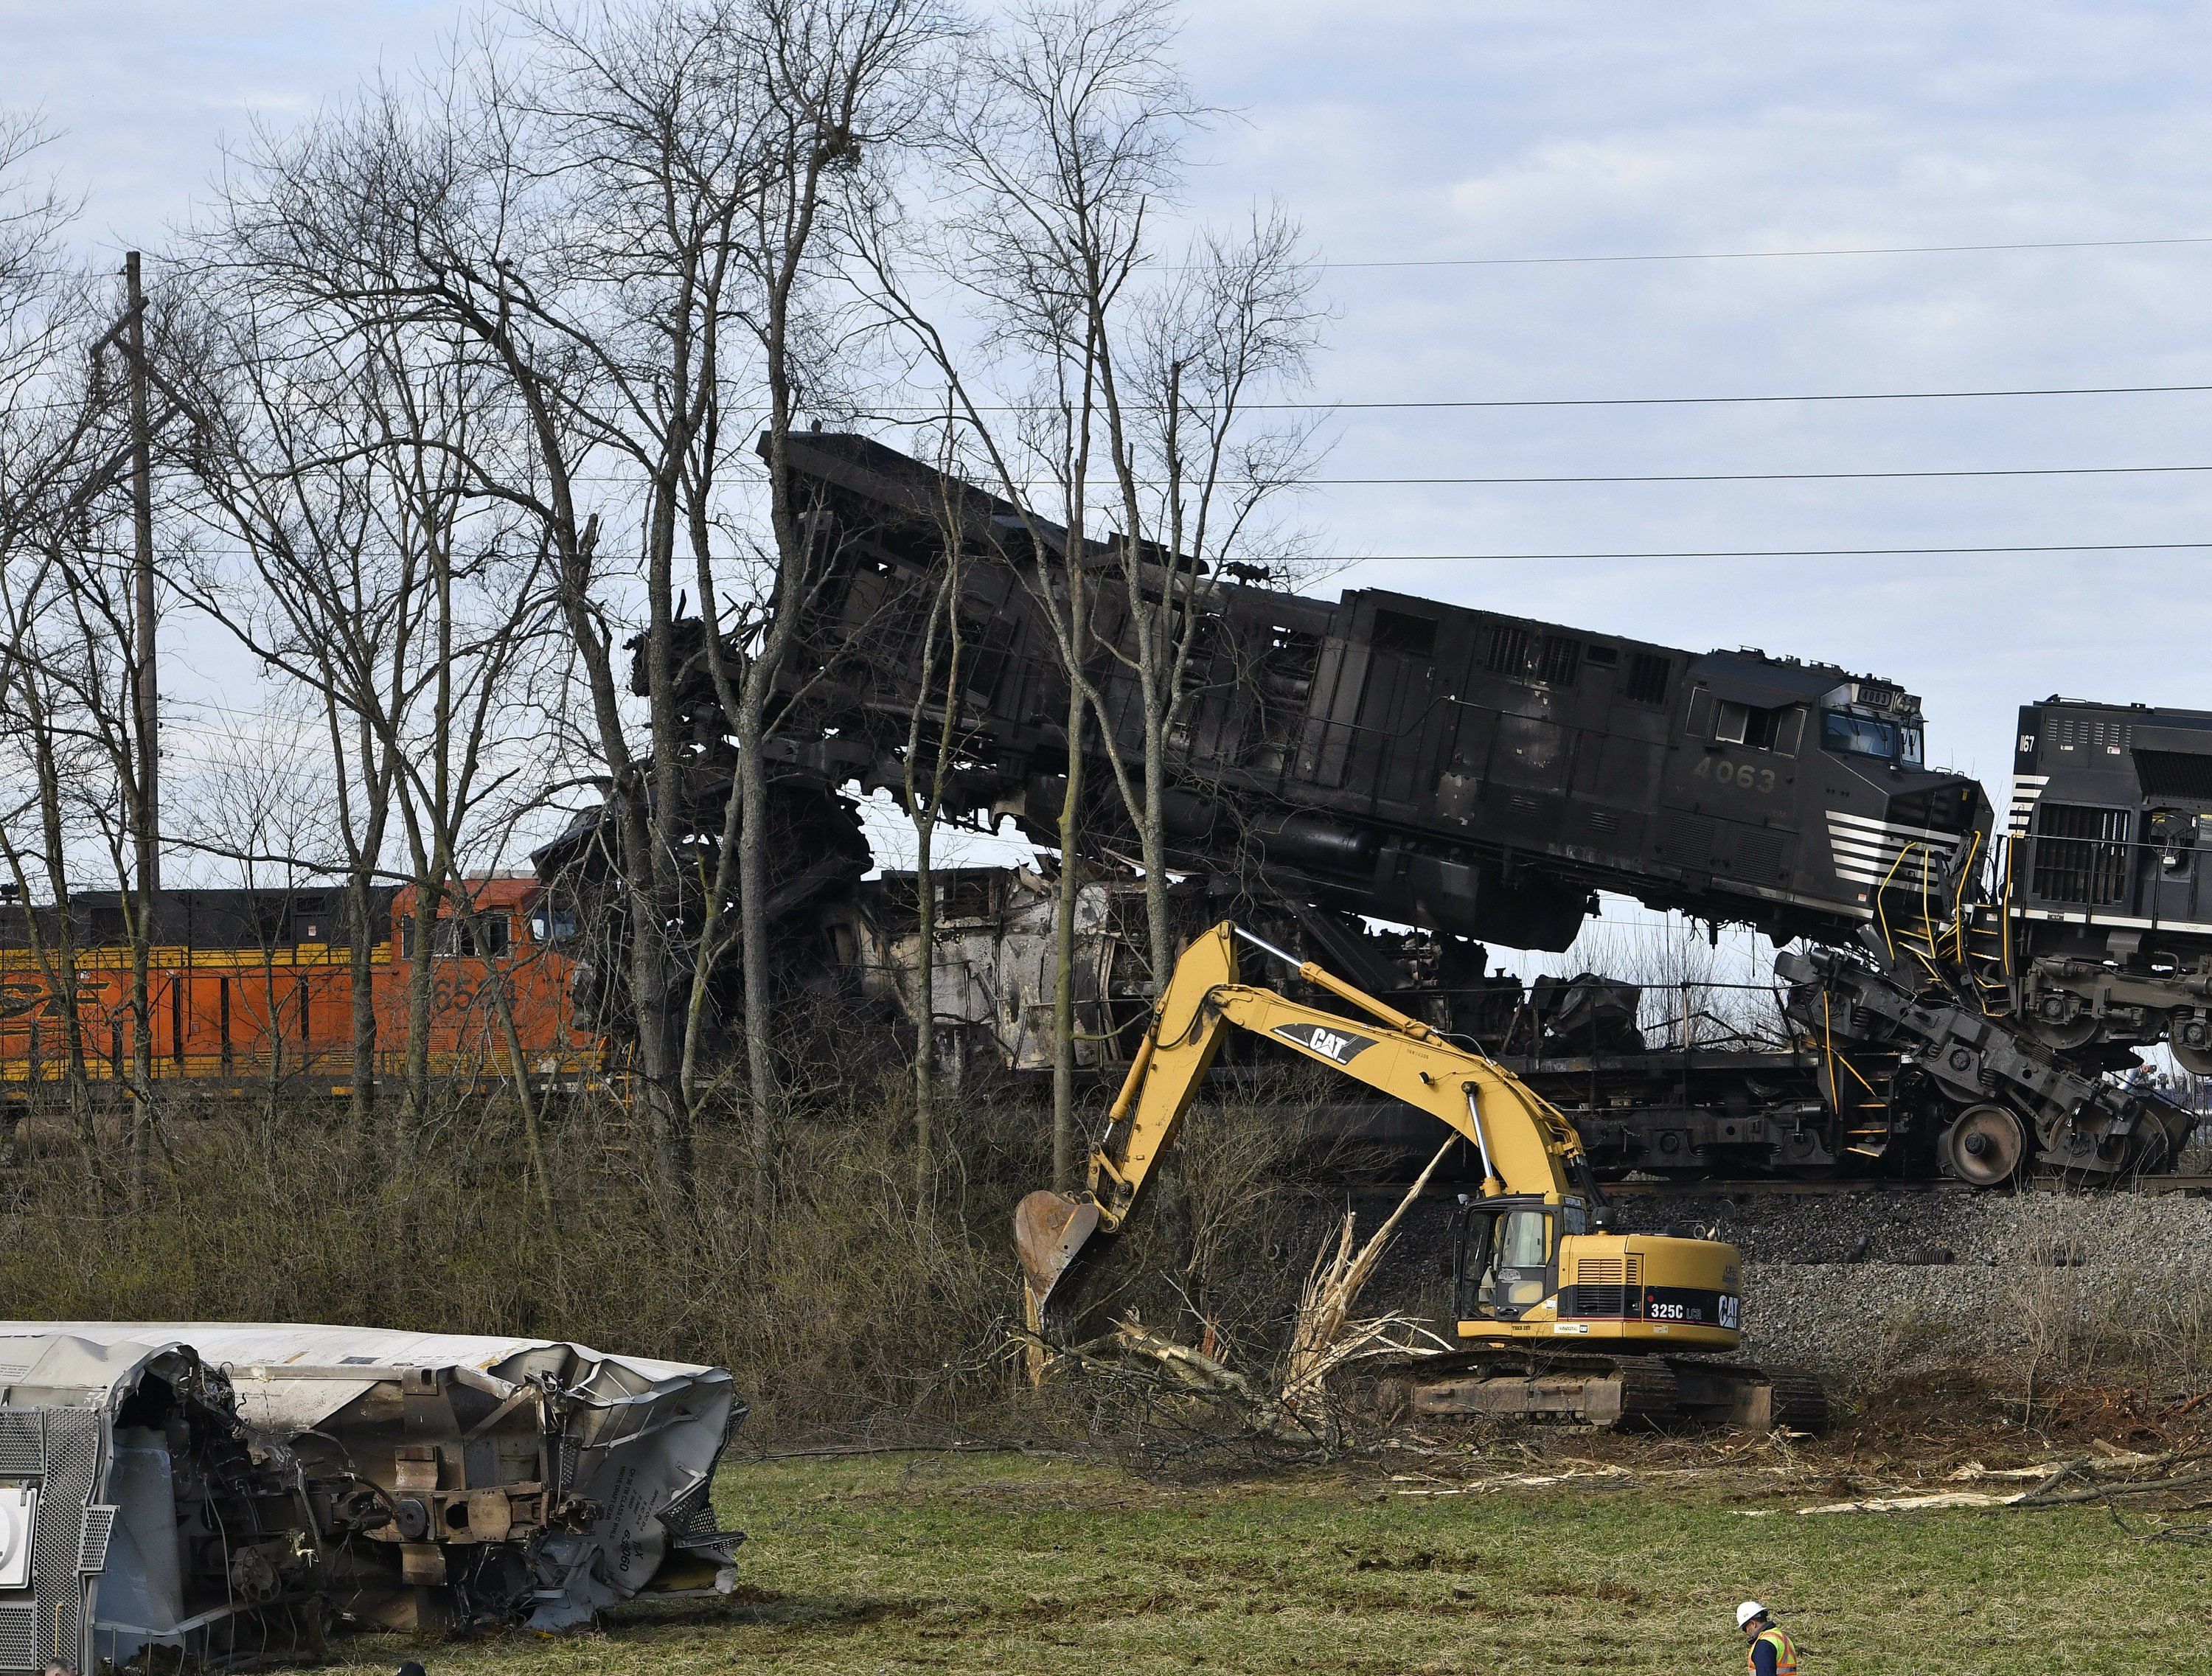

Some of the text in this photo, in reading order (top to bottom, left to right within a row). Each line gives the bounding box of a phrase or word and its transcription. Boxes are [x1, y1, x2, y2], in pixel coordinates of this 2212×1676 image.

[1863, 690, 1887, 704] 4063
[2019, 734, 2035, 752] 1167
[1693, 757, 1775, 793] 4063
[1310, 1028, 1348, 1060] CAT
[1651, 1303, 1683, 1319] 325C
[1718, 1294, 1739, 1329] CAT
[611, 1484, 620, 1504] DRAFT
[605, 1504, 614, 1521] GEAR
[616, 1495, 627, 1516] CLASS
[609, 1522, 619, 1540] WHLS
